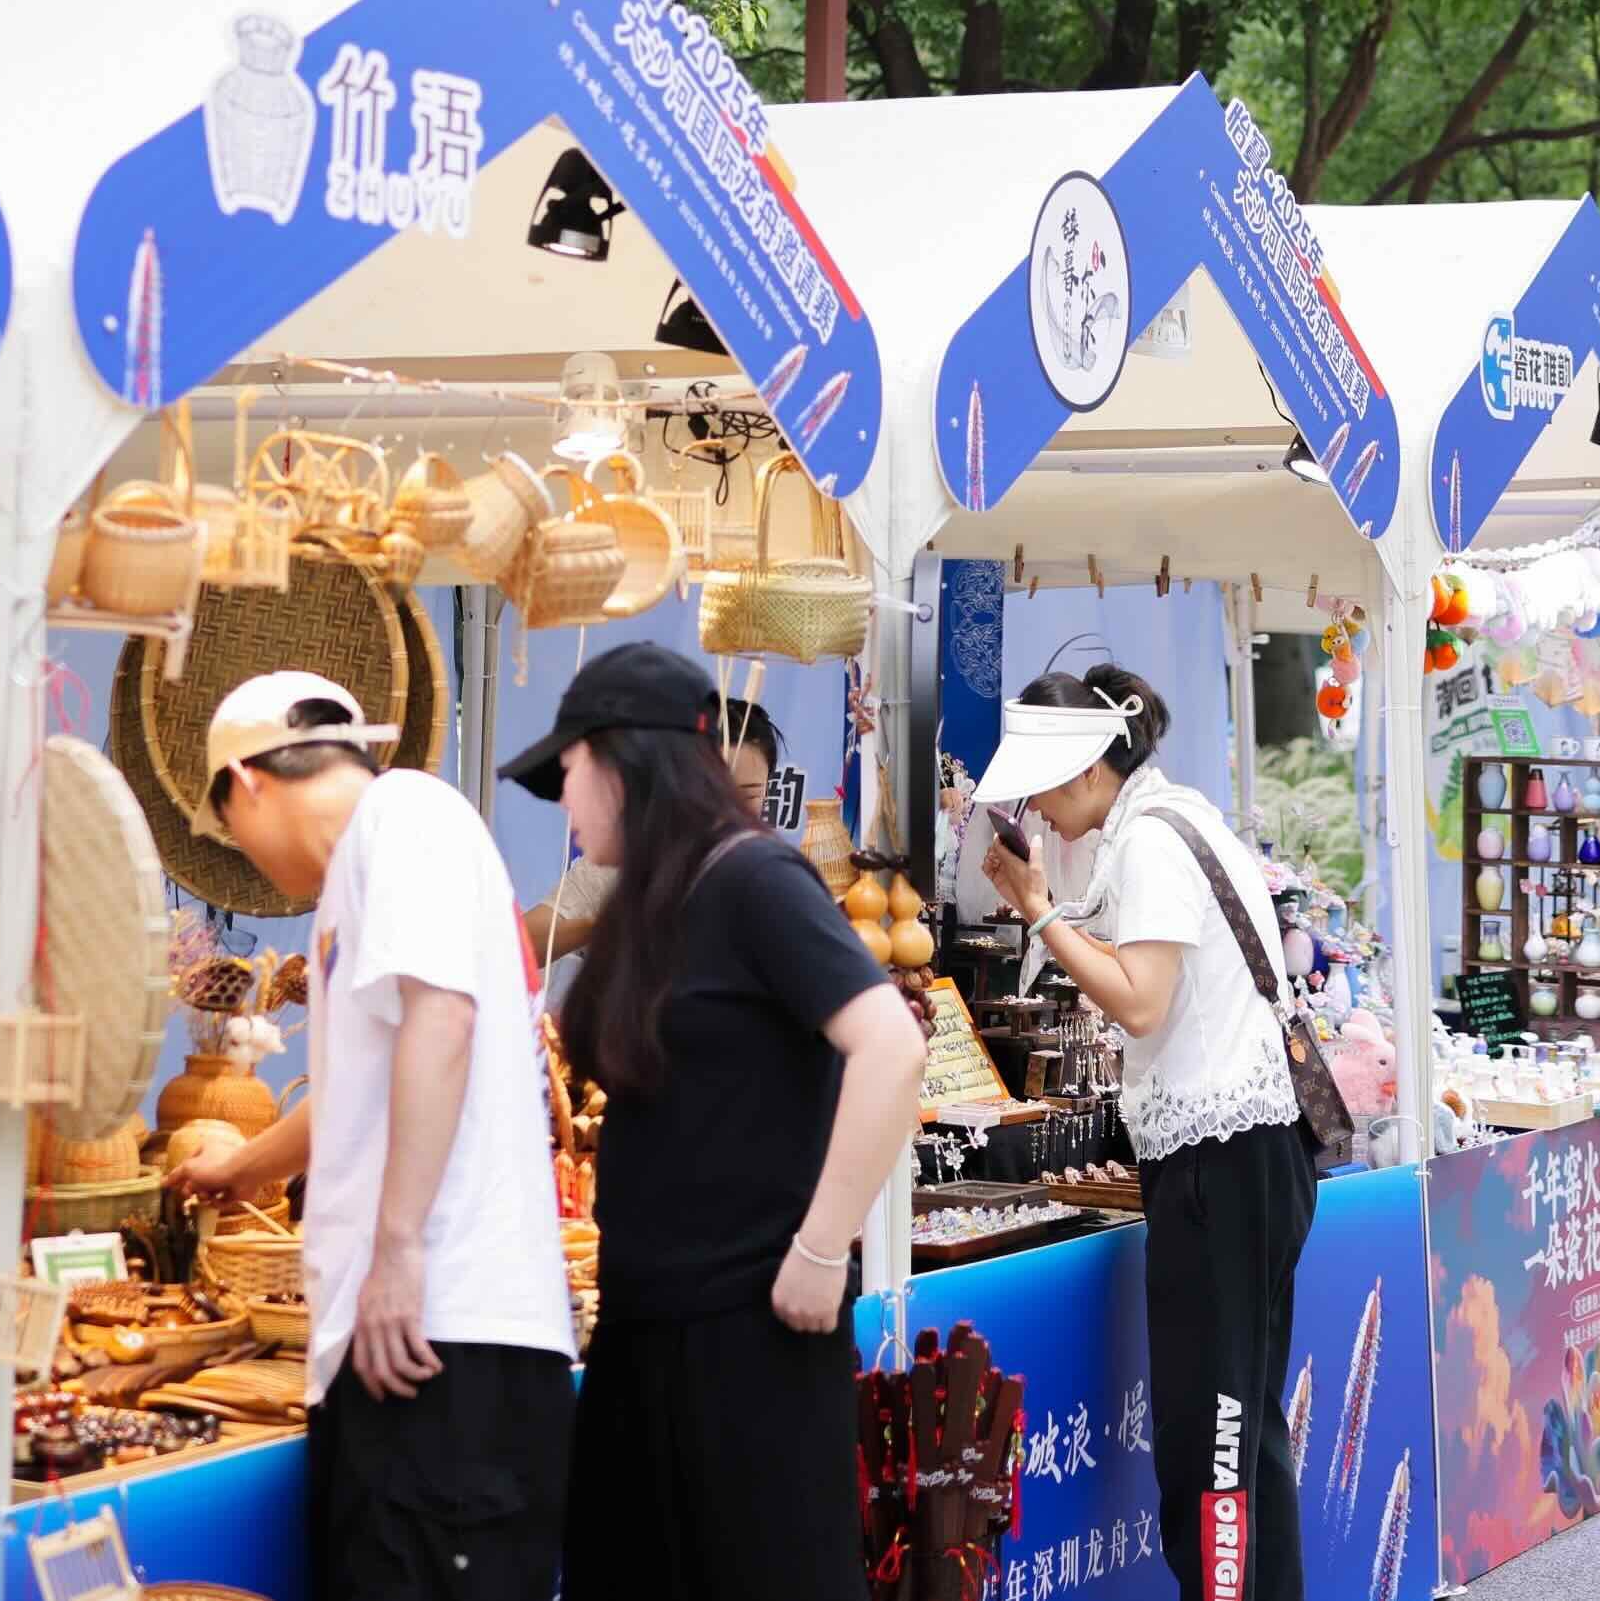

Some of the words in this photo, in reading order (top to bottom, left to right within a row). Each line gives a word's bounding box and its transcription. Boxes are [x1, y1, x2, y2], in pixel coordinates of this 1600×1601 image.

[324, 51, 480, 181] 竹语
[330, 167, 469, 233] ZHUYU
[614, 1, 841, 344] 大沙河国际龙舟邀请赛
[1233, 171, 1371, 421] 大沙河国际龙舟邀请赛
[1008, 1379, 1152, 1484] 破浪·慢
[1213, 1392, 1242, 1490] ANTA
[983, 1510, 1164, 1601] 年深圳龙舟文
[1214, 1497, 1239, 1601] ORIGI
